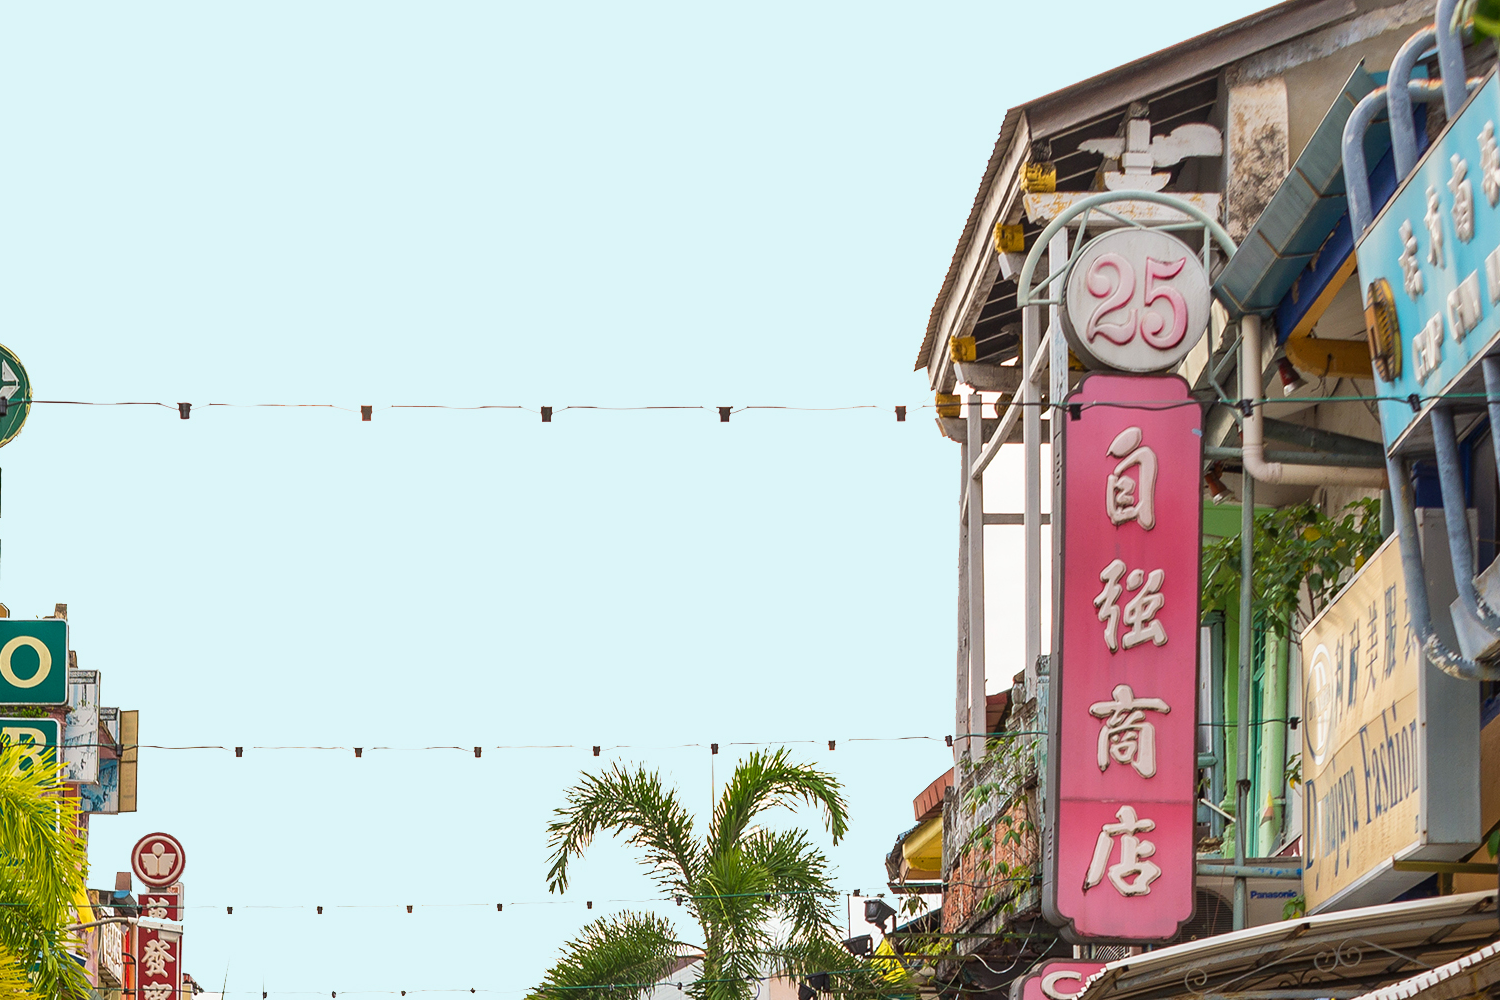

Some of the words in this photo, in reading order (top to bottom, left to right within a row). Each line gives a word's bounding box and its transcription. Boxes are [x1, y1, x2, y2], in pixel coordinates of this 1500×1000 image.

[1086, 252, 1188, 351] 25
[1359, 701, 1419, 825] Fashion
[1250, 889, 1298, 899] Panasonic
